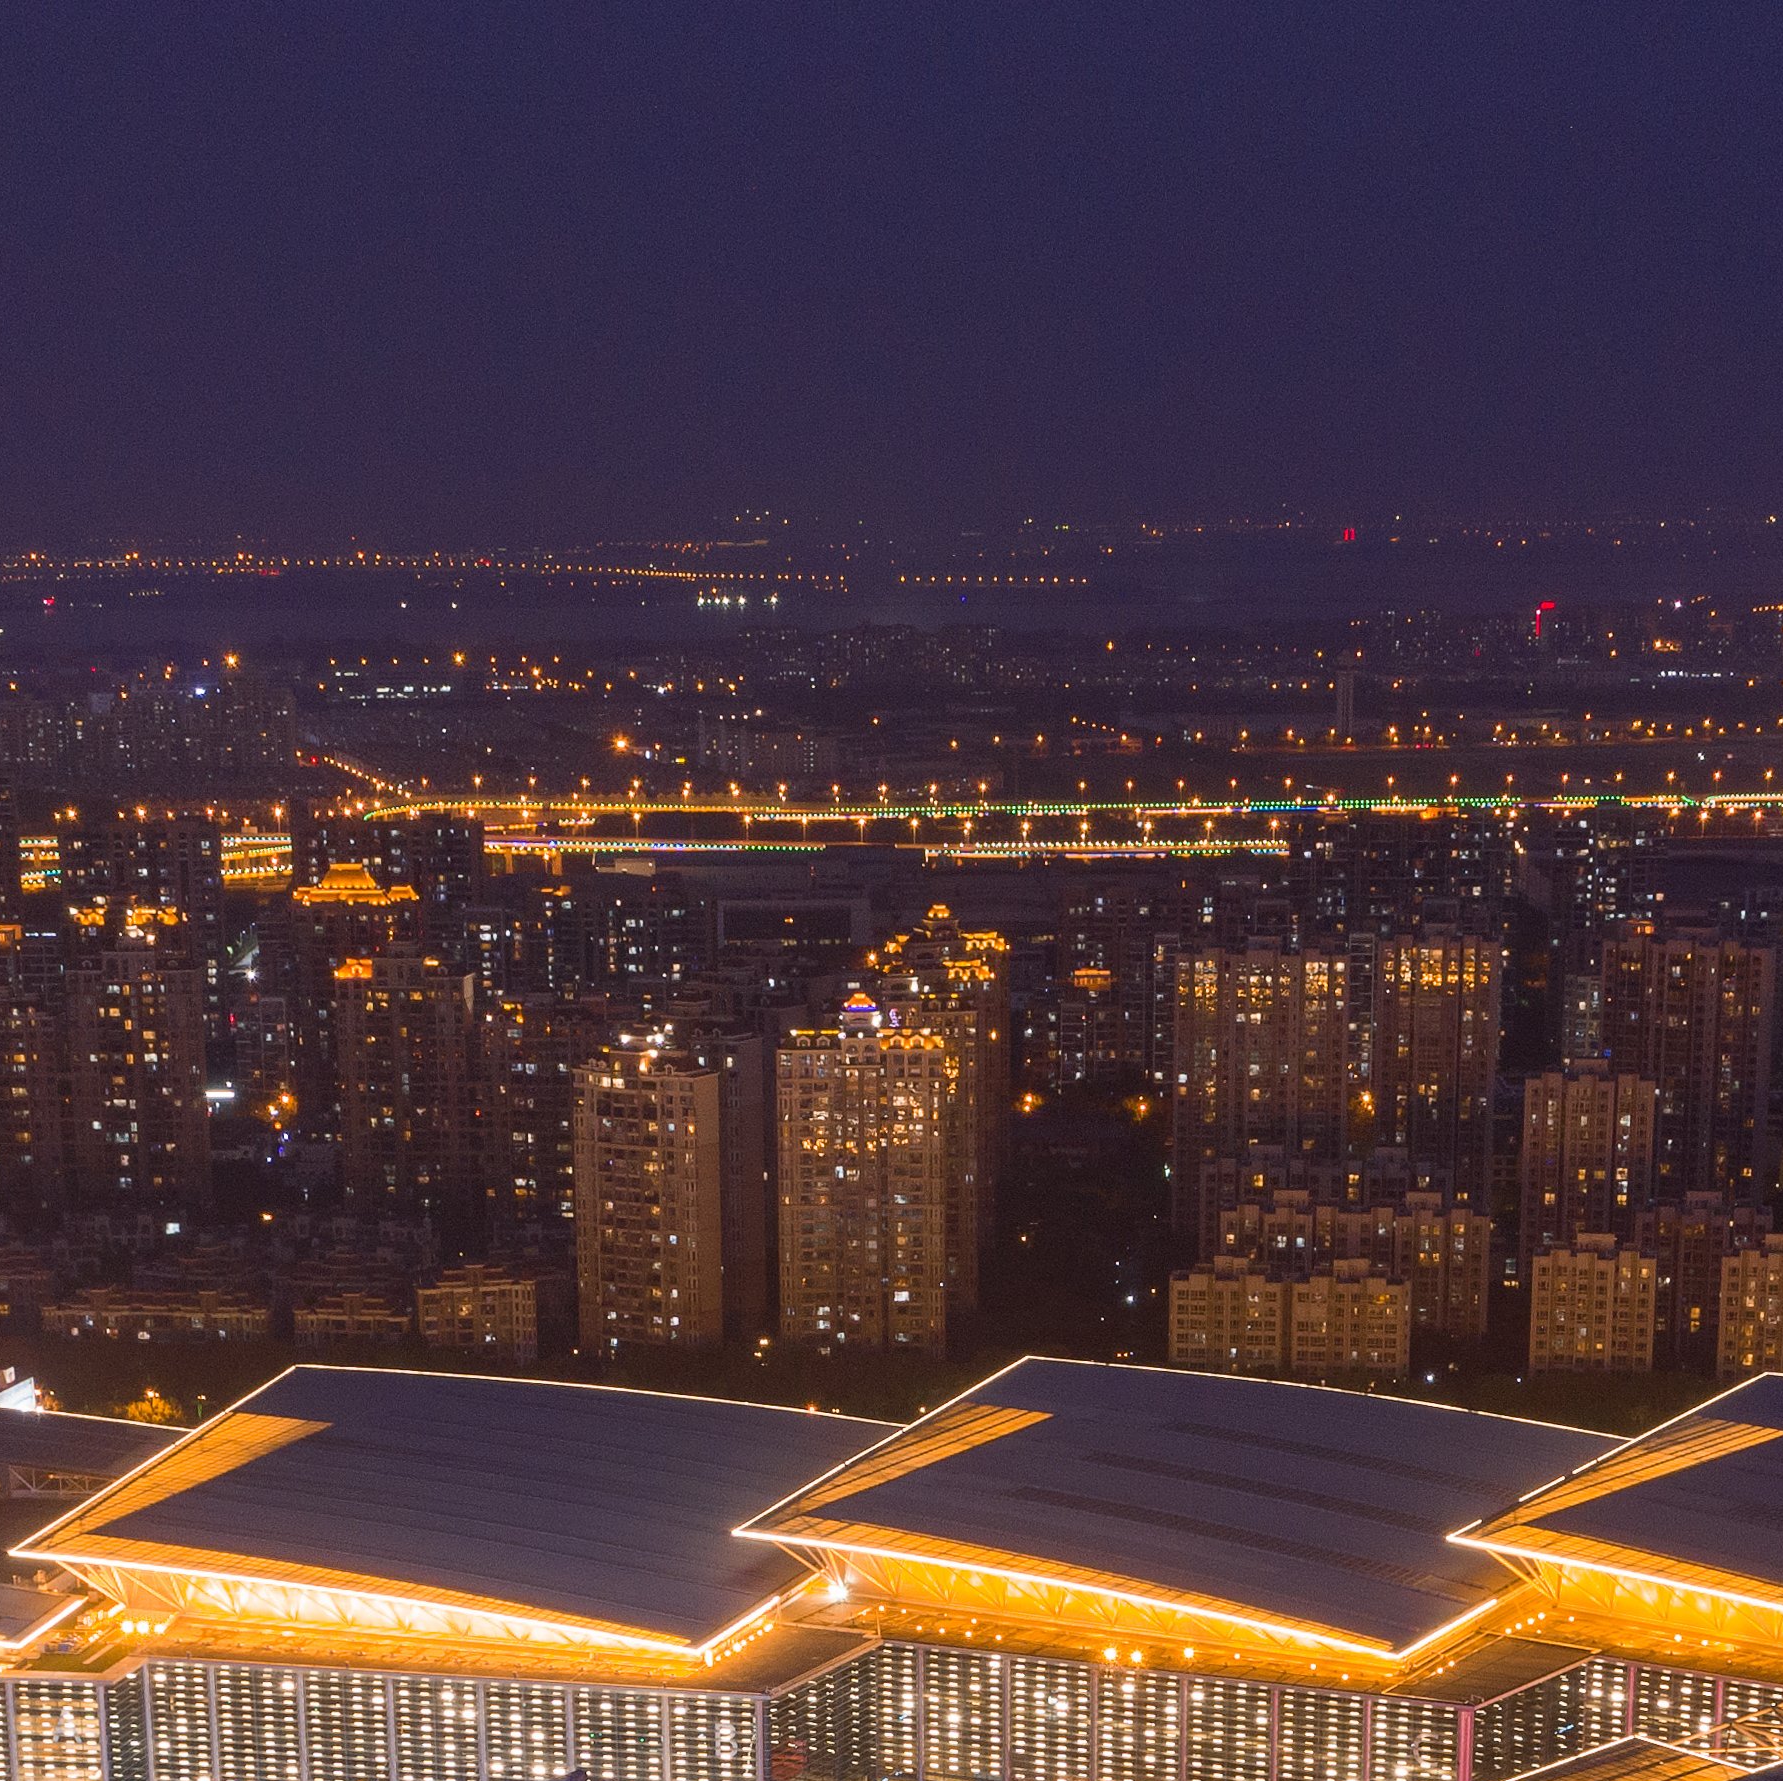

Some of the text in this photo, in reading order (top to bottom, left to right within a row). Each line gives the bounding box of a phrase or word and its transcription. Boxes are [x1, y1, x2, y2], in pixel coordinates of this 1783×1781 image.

[53, 1708, 83, 1744] A
[714, 1723, 738, 1758] B
[1413, 1733, 1439, 1768] C
